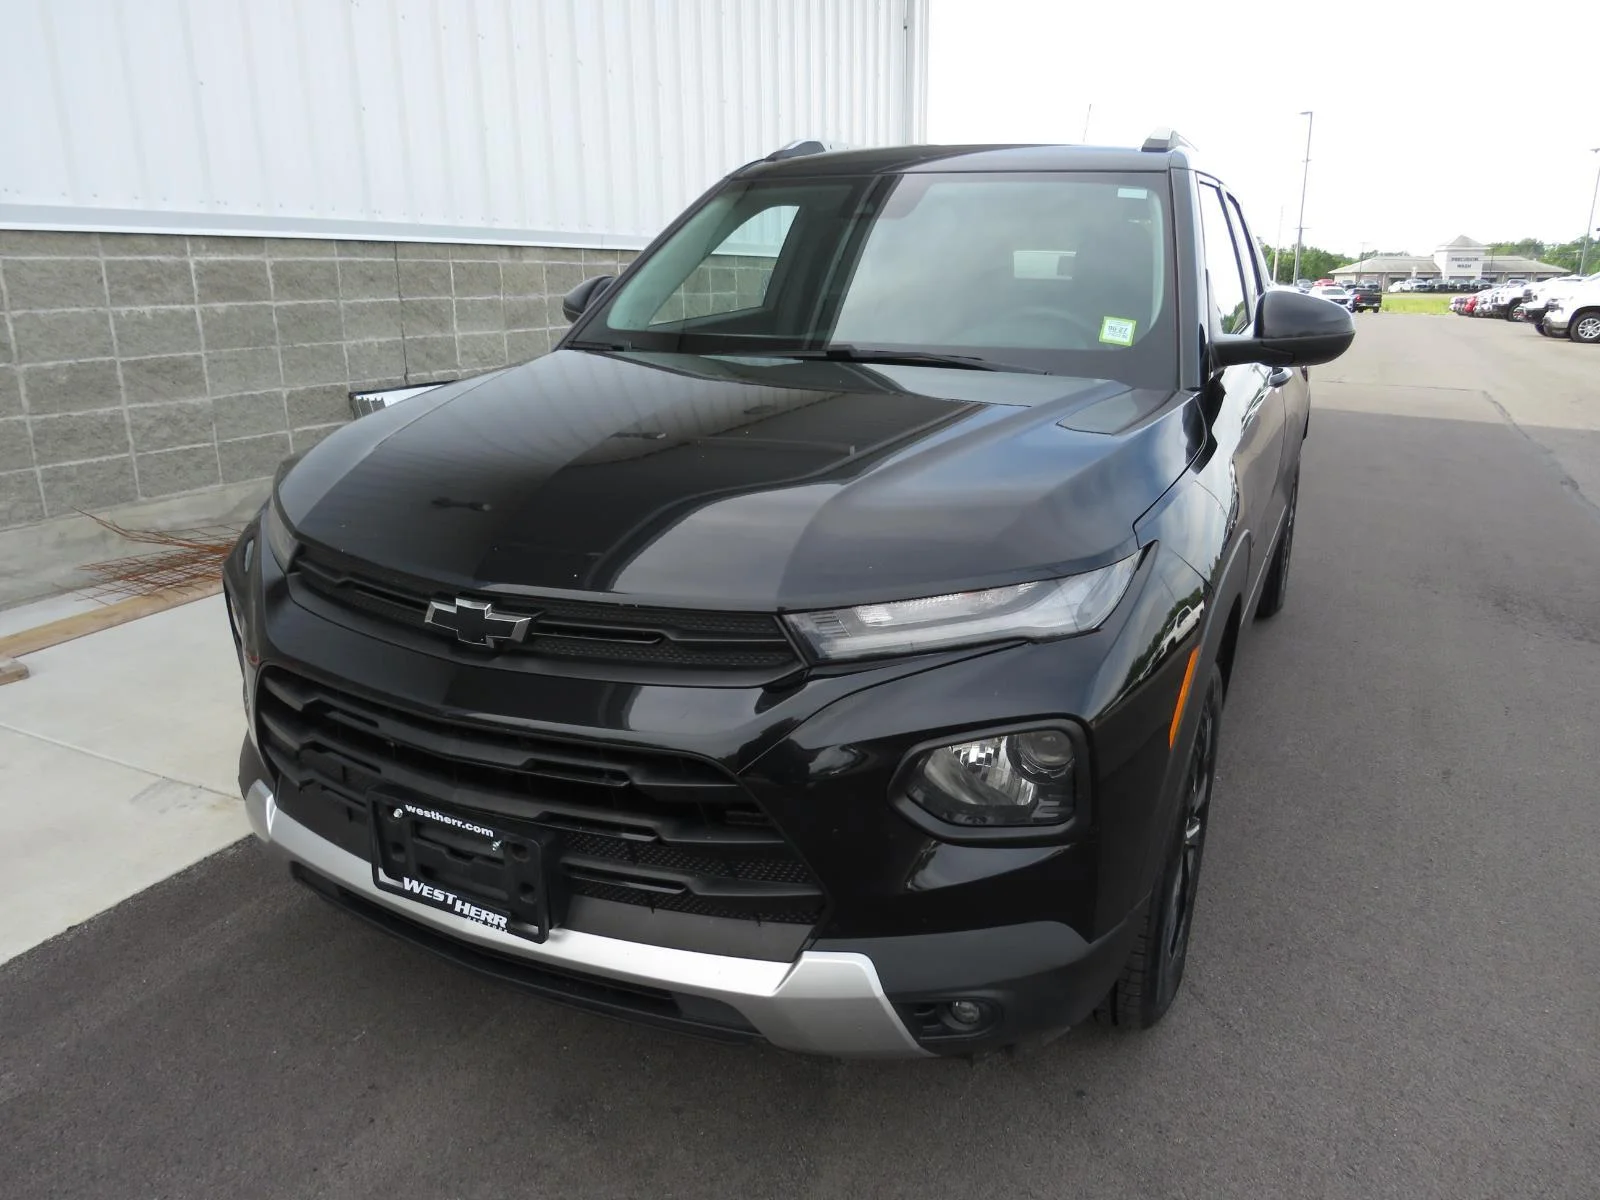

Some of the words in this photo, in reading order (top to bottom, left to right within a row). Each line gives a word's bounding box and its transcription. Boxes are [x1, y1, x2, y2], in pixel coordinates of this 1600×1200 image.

[405, 804, 494, 837] westherr.com
[403, 876, 457, 904] WEST
[454, 900, 507, 928] HERR
